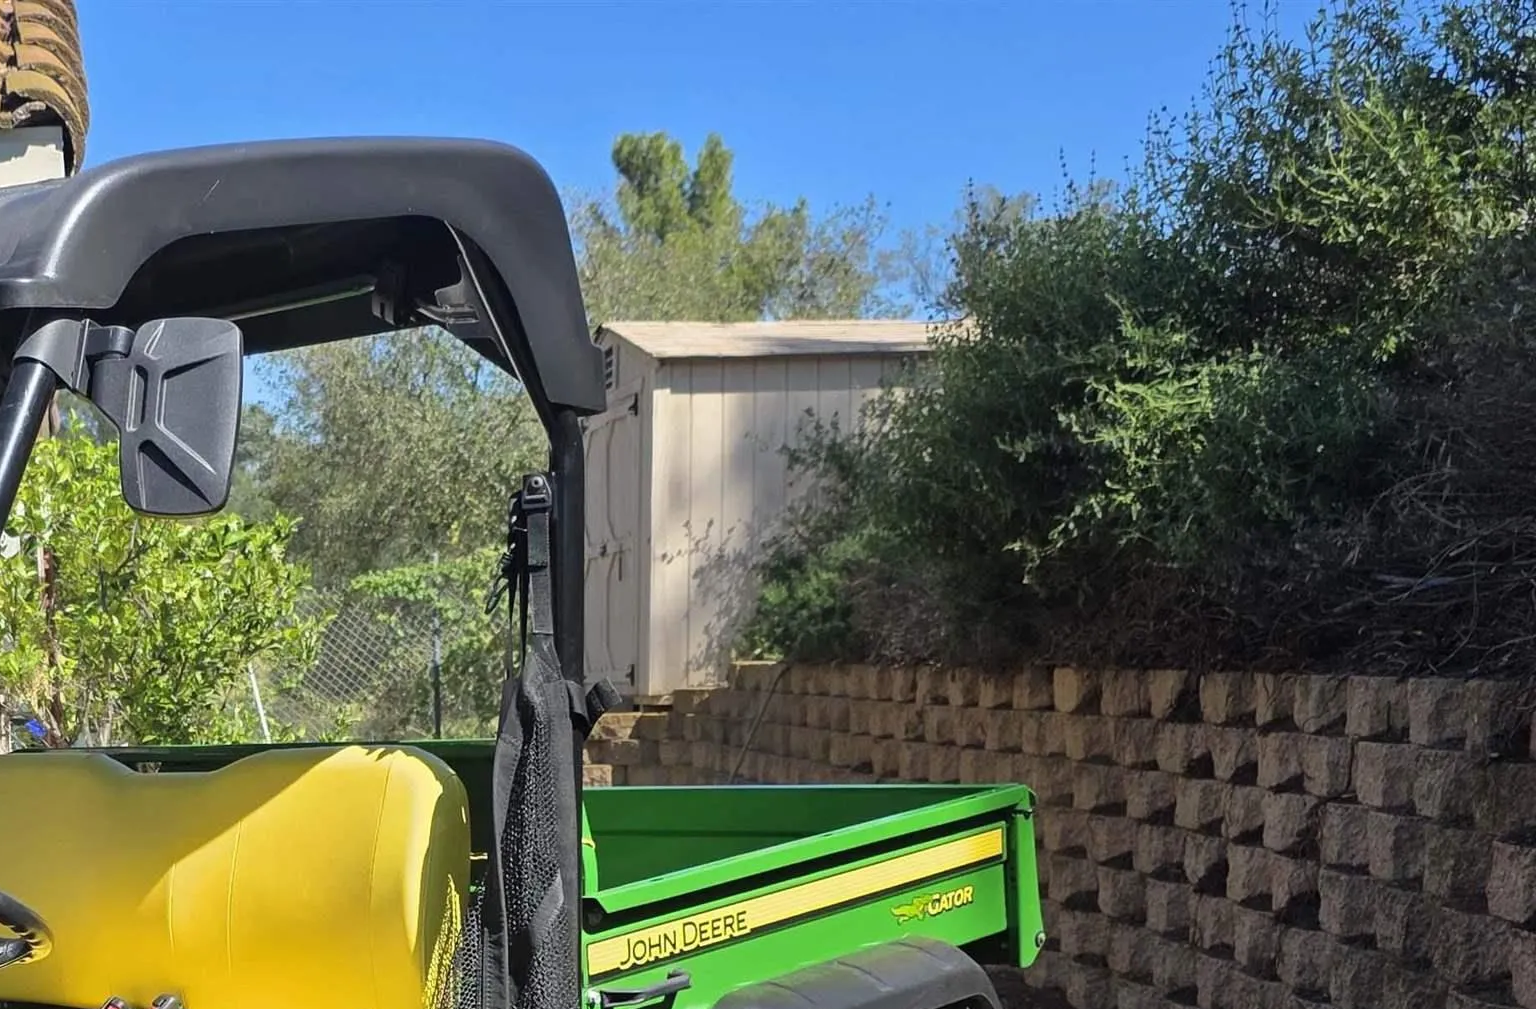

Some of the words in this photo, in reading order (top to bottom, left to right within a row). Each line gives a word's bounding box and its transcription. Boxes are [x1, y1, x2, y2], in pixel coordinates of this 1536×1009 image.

[928, 886, 973, 915] GATOR
[620, 930, 676, 965] JOHN
[682, 910, 748, 946] DEERE
